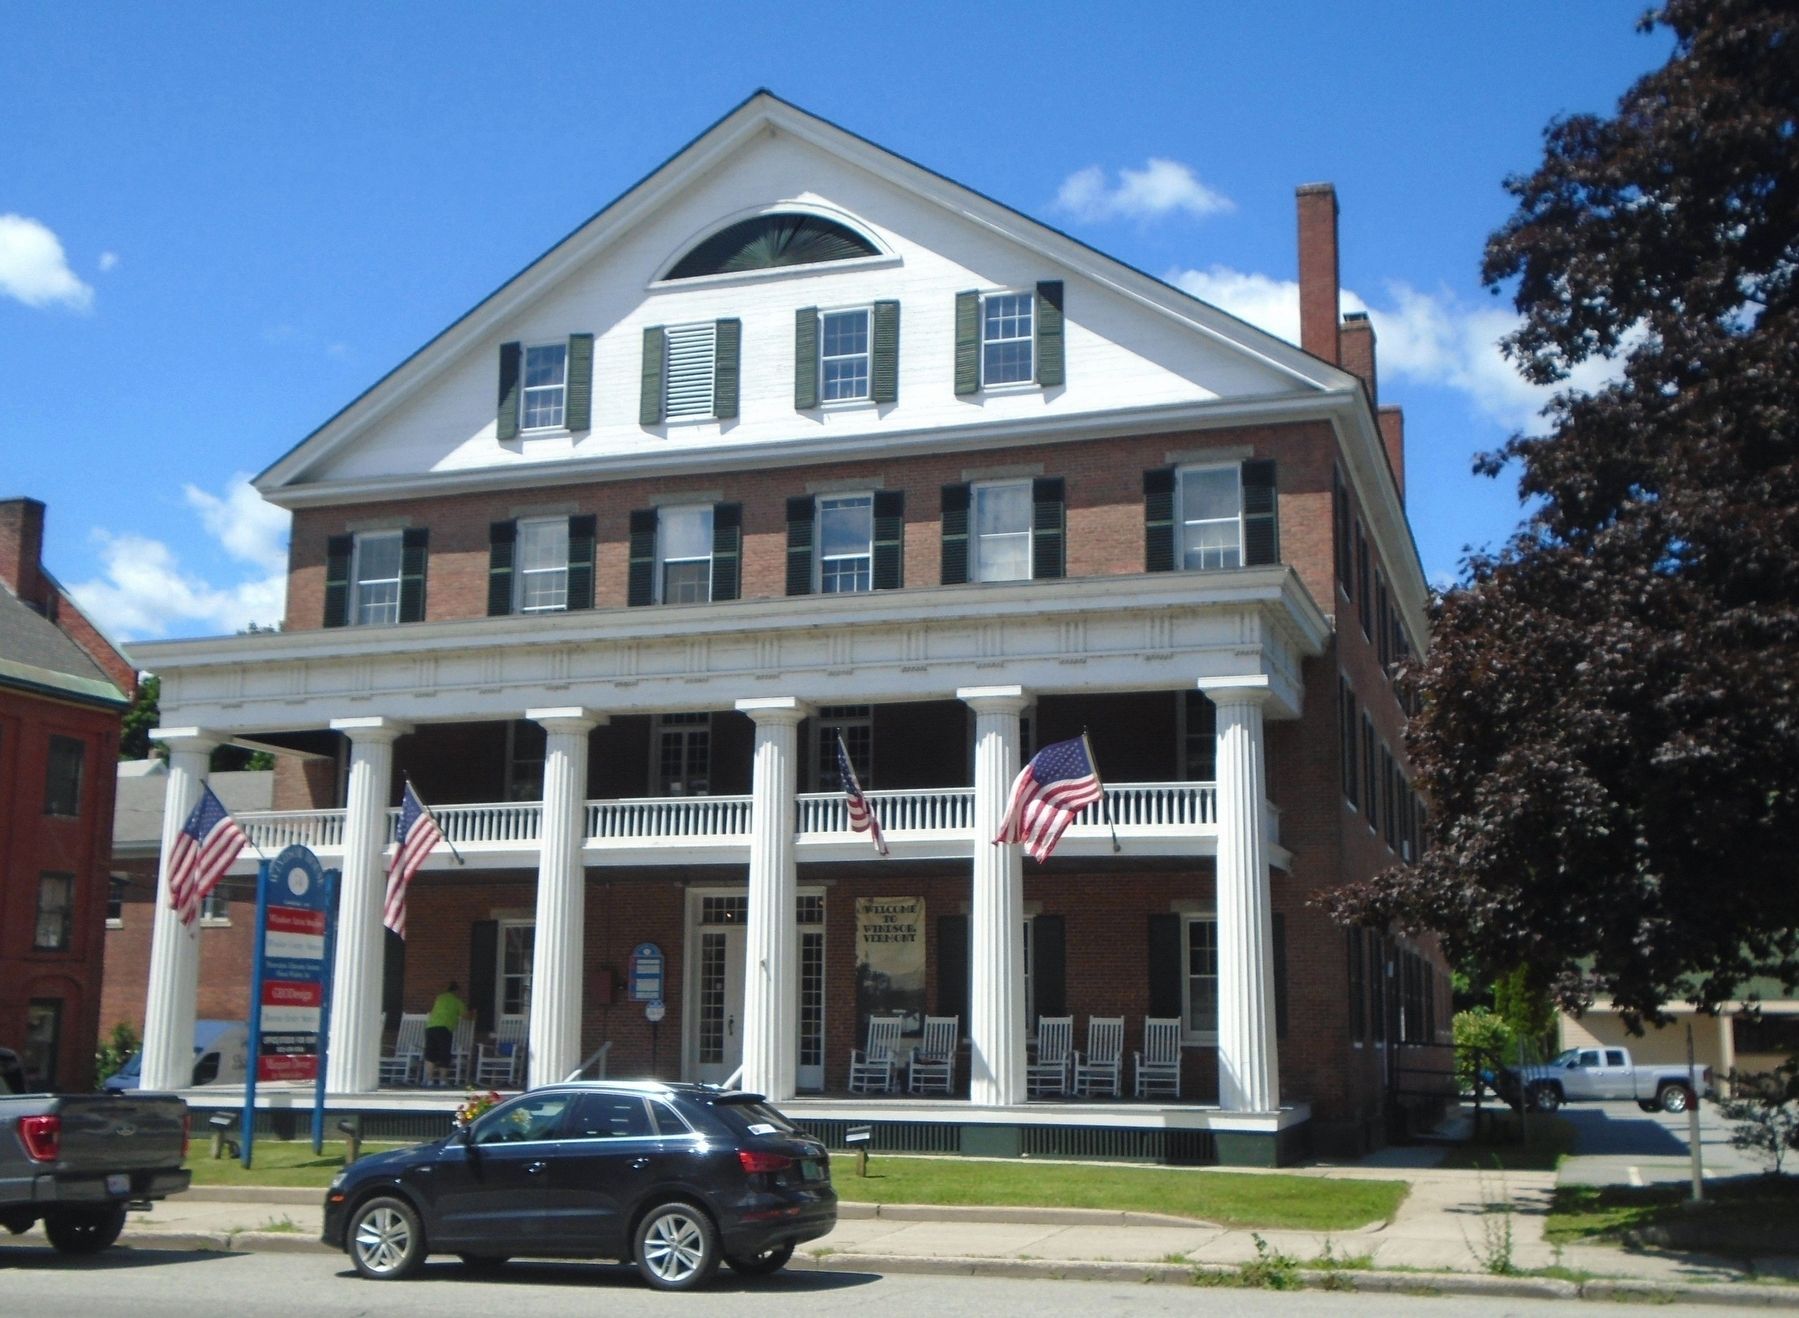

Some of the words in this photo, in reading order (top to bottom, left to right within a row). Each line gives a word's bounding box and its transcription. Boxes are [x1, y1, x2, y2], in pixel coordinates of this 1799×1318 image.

[864, 905, 916, 913] WELCOME
[884, 915, 896, 923] TO
[863, 934, 916, 942] VERMONT
